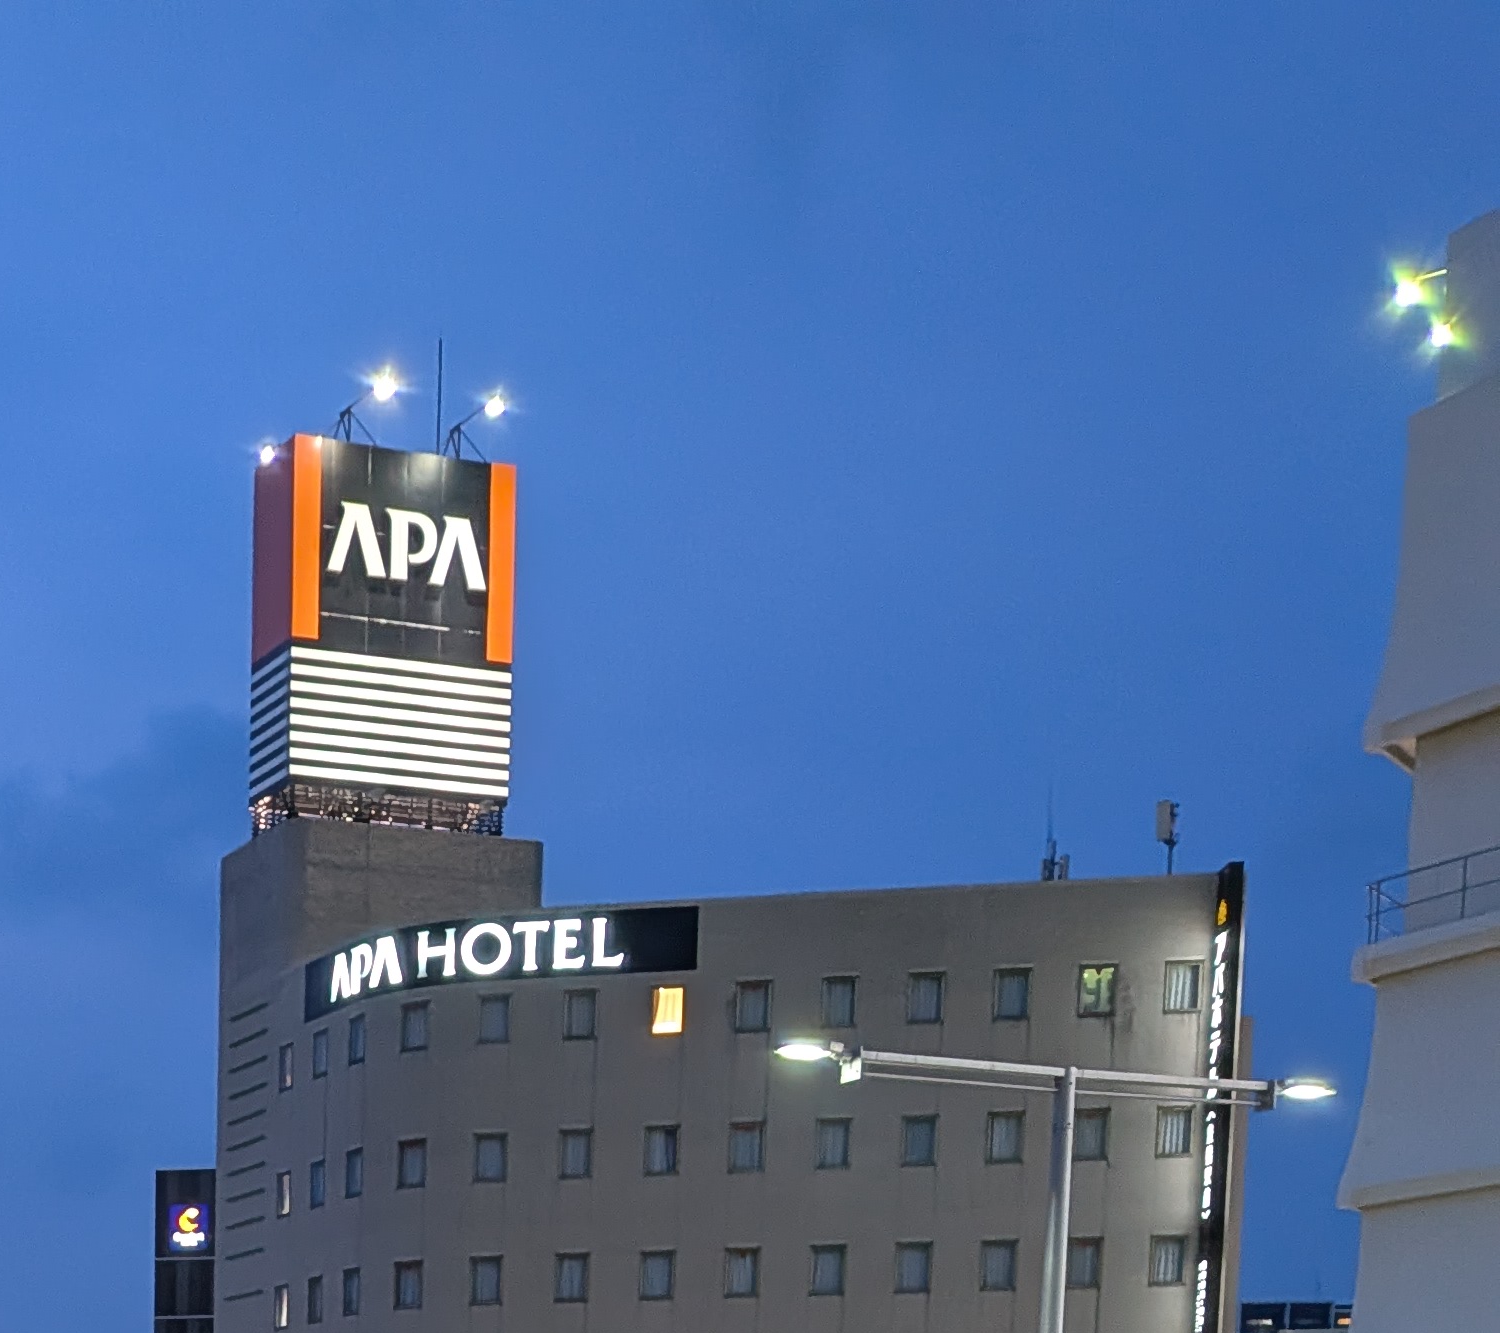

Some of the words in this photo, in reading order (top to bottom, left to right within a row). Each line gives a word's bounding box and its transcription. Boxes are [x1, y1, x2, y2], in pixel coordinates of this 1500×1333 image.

[327, 502, 487, 592] APA
[329, 935, 403, 1004] APA
[416, 916, 625, 980] HOTEL
